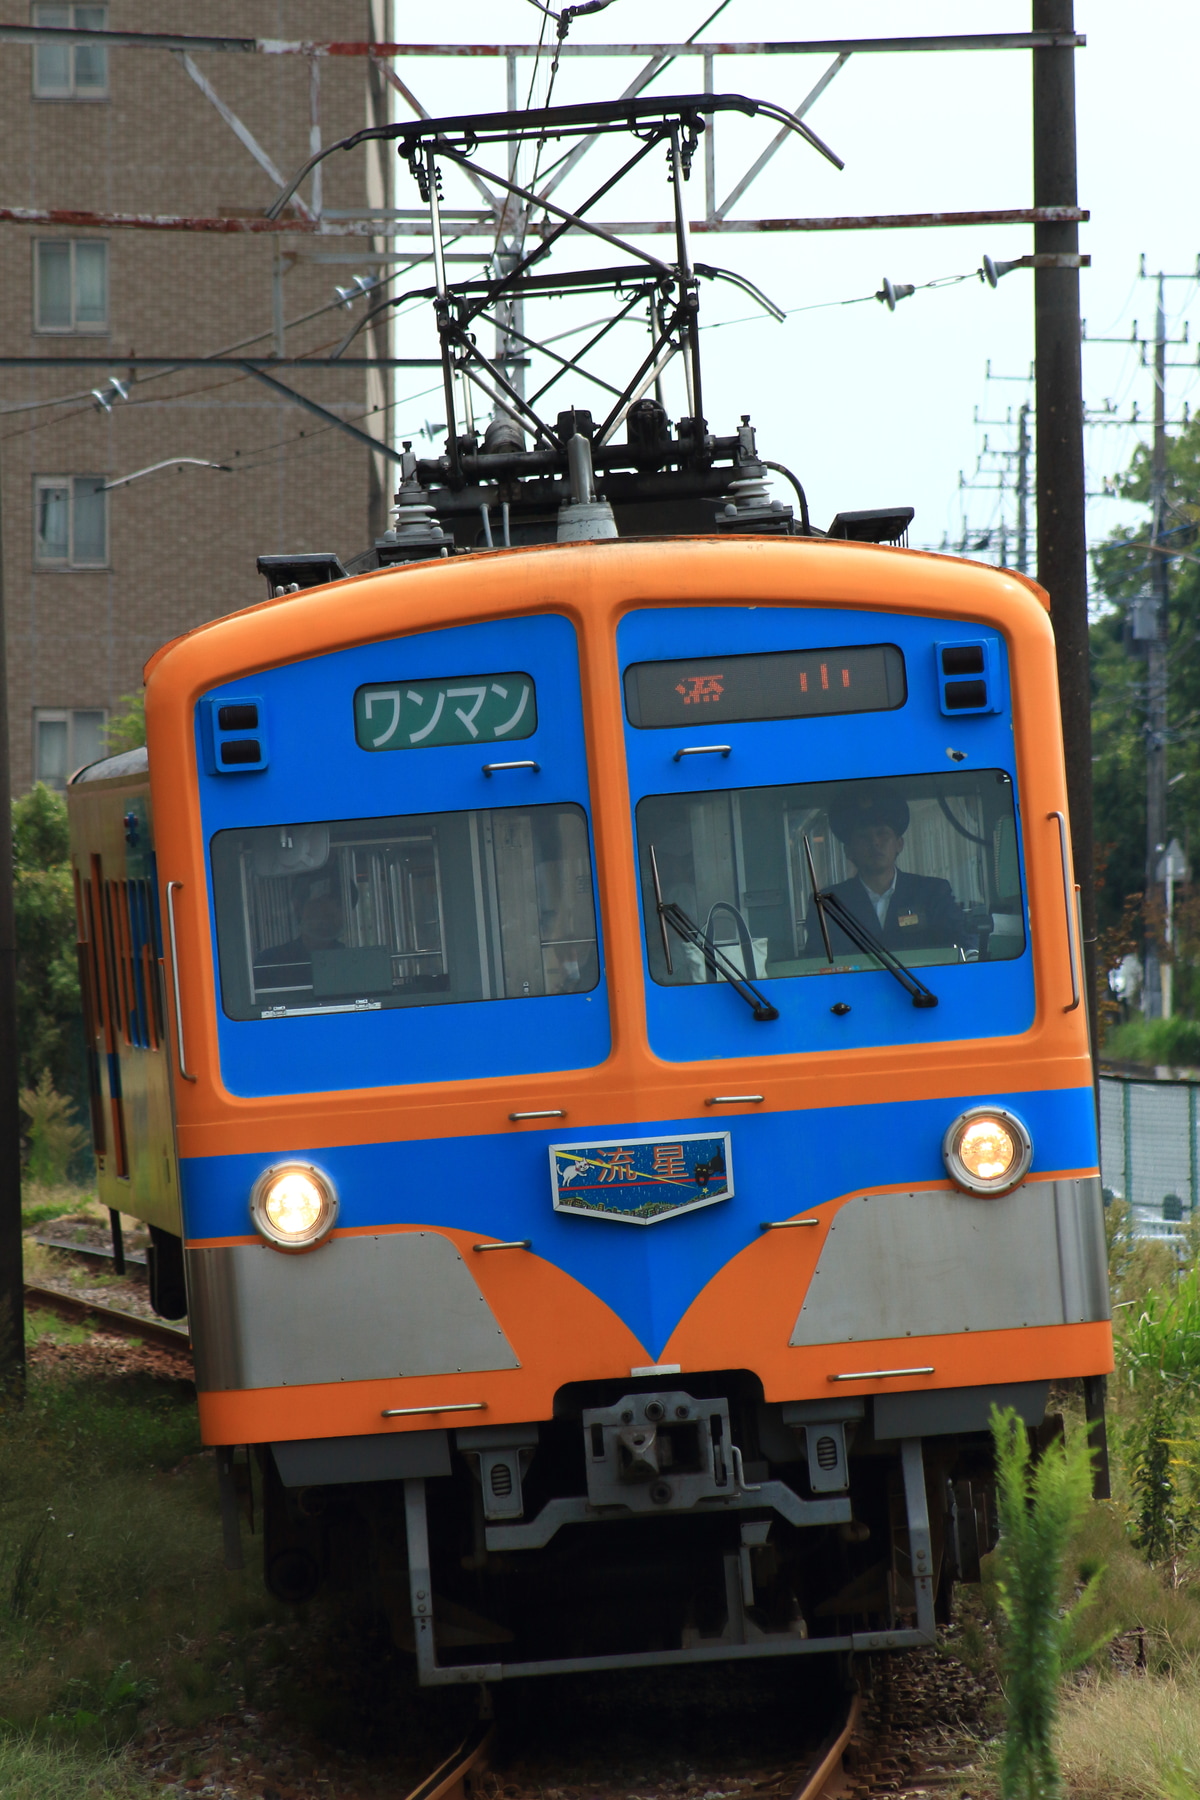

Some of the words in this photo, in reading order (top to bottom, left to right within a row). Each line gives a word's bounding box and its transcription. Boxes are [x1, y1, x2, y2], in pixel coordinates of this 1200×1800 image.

[365, 683, 529, 747] ワンマン
[596, 1145, 689, 1182] 流星
